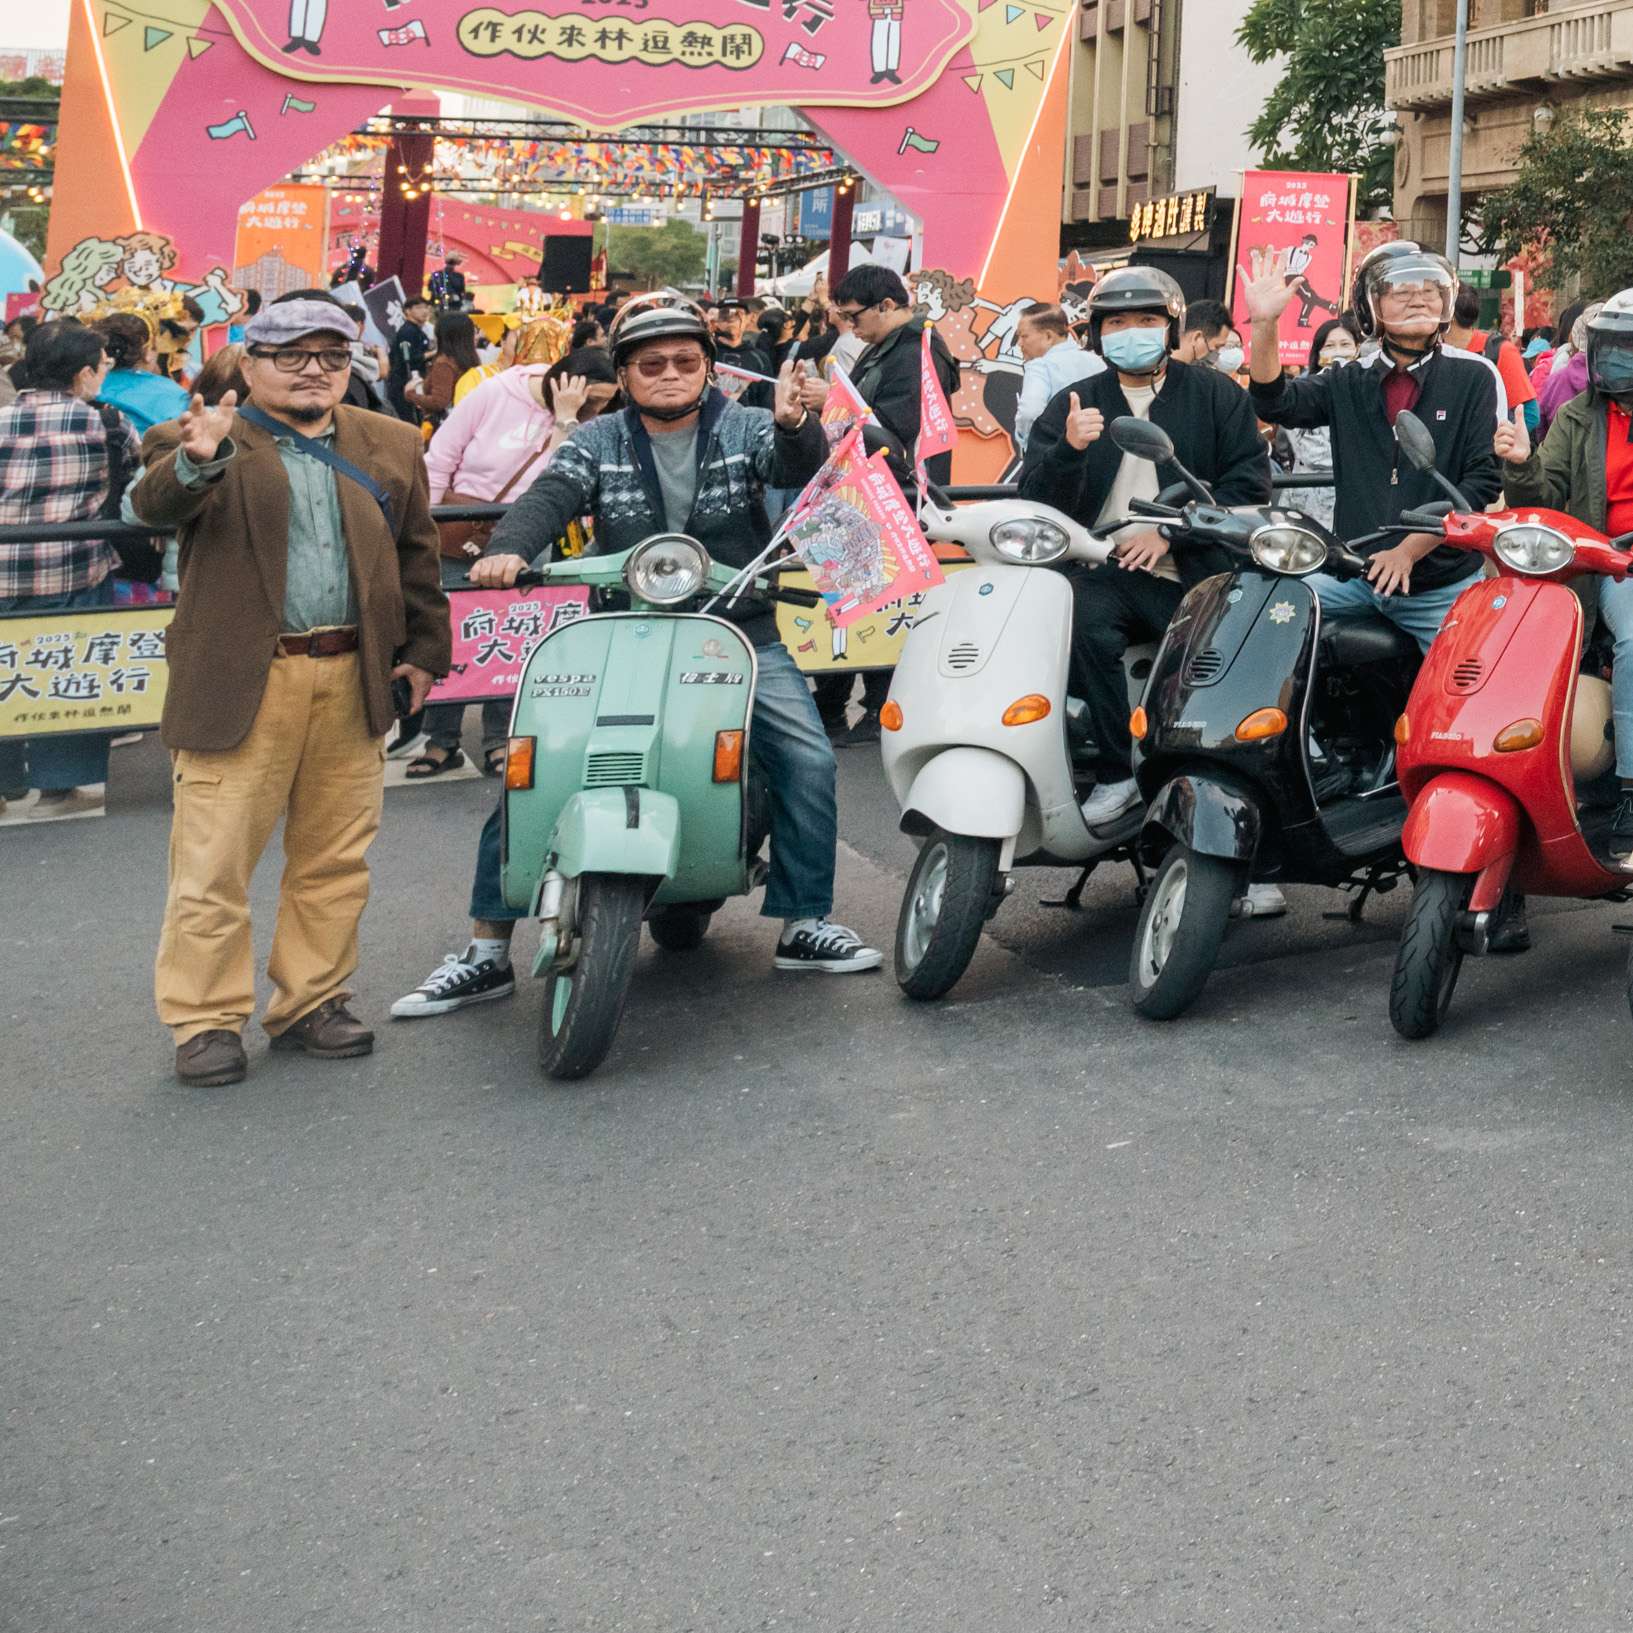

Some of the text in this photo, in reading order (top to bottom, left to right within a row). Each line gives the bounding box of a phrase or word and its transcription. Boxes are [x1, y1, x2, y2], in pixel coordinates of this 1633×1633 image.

[468, 20, 754, 60] 作伙來林逗熱鬧
[1259, 191, 1330, 209] 府城摩登
[1266, 209, 1322, 225] 大遊行
[508, 602, 541, 613] 2025
[35, 633, 71, 645] 2025
[0, 667, 151, 702] 大遊行
[535, 674, 597, 684] vespa
